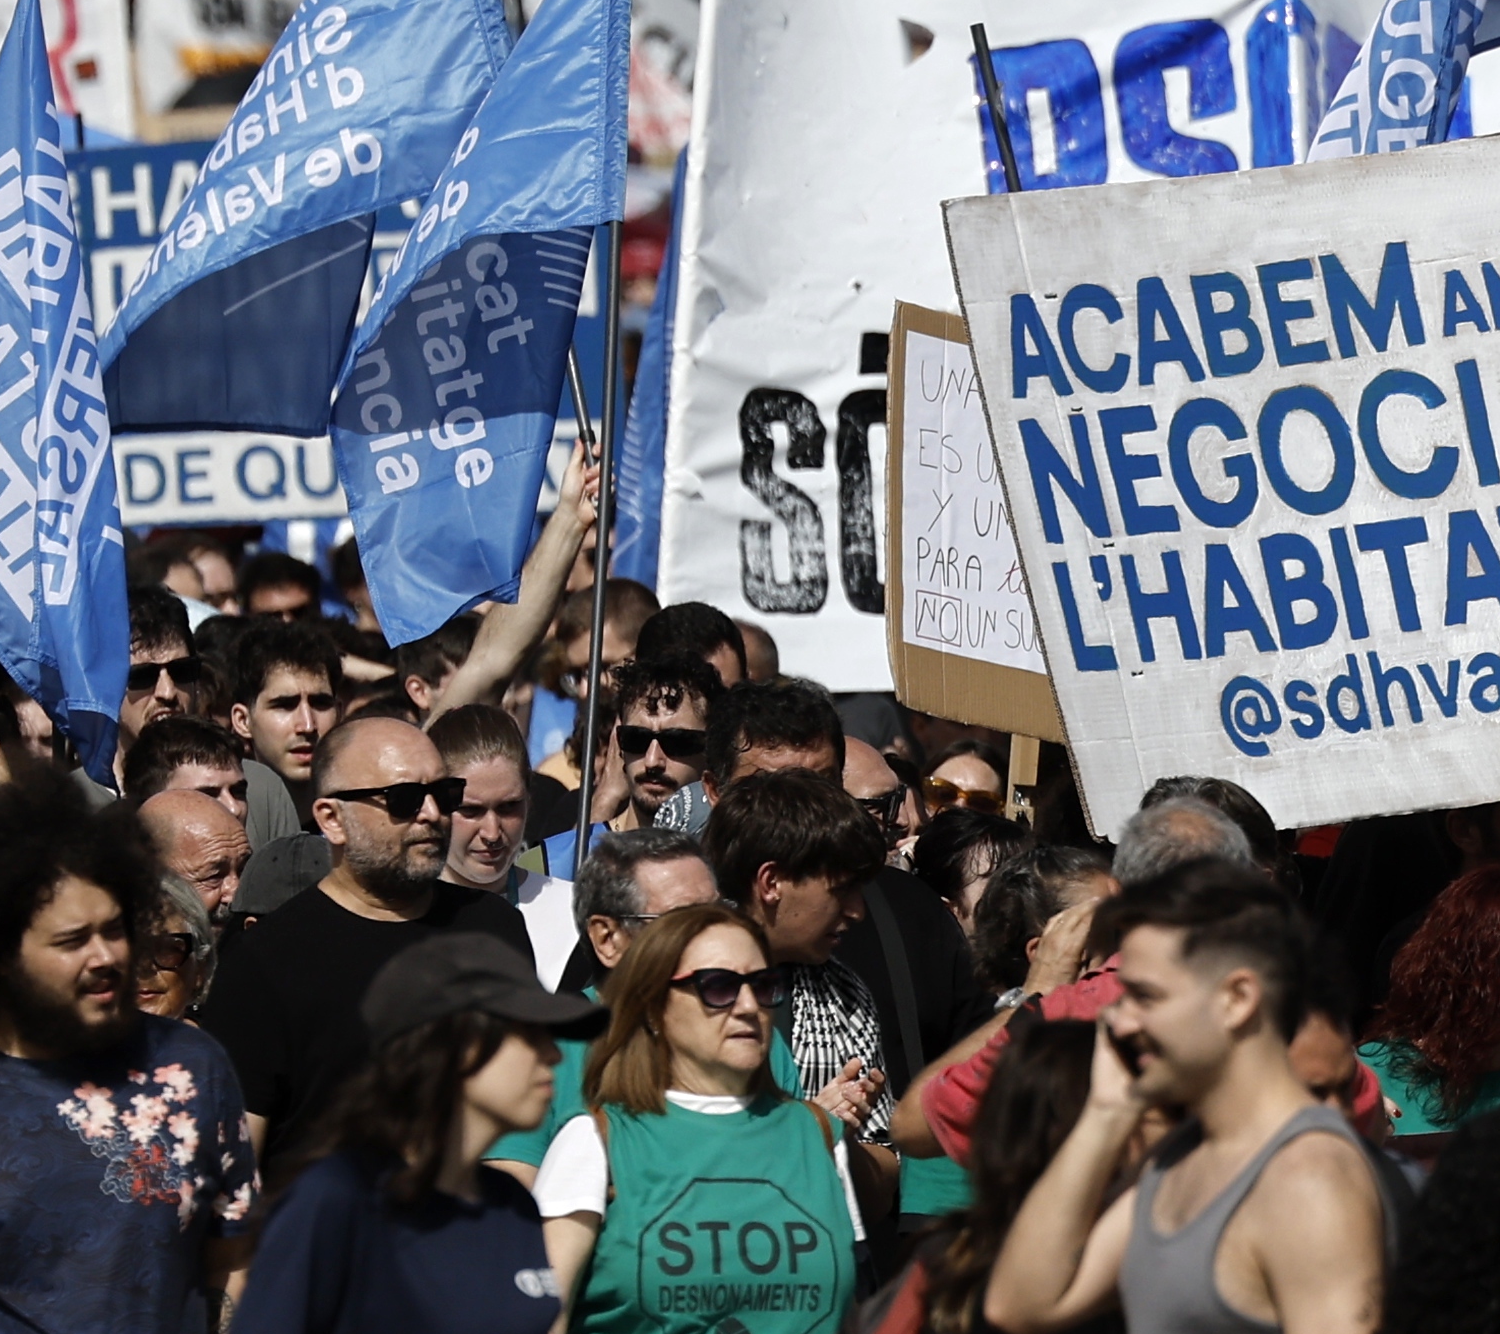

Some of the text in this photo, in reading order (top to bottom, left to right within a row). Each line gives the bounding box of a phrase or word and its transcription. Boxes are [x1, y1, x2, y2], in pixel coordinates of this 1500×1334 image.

[1009, 241, 1425, 399] ACABEM
[124, 447, 214, 505] DE
[919, 428, 962, 474] ES
[928, 489, 954, 532] Y
[916, 536, 983, 592] PARA
[916, 597, 960, 643] NO
[966, 603, 997, 650] UN
[656, 1220, 818, 1277] STOP
[658, 1282, 821, 1314] DESNONAMENTS
